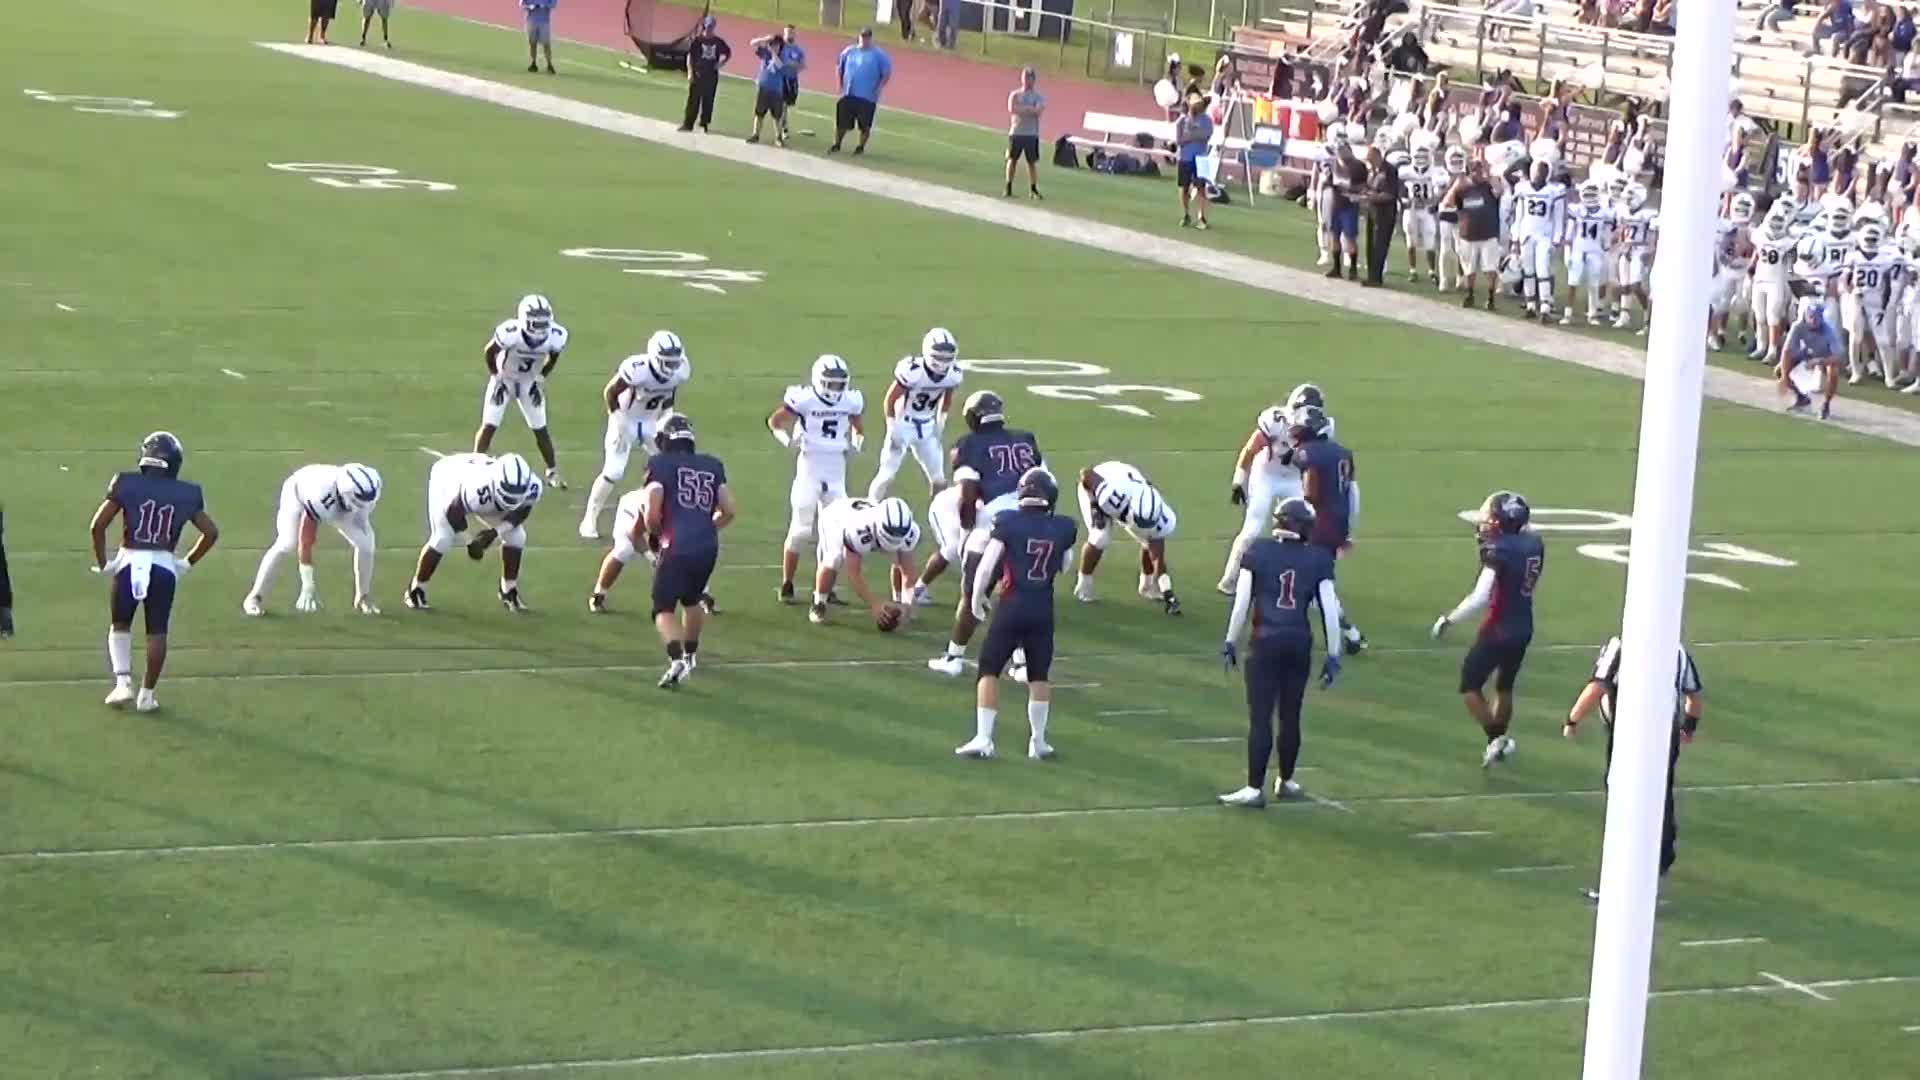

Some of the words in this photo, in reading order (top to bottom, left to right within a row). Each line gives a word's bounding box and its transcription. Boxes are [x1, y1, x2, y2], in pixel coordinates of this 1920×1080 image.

[1527, 199, 1547, 217] 23
[1856, 269, 1879, 288] 20
[518, 356, 537, 373] 3
[956, 358, 1204, 402] 30
[911, 392, 944, 411] 34
[821, 420, 838, 440] 5
[677, 466, 716, 510] 55
[134, 498, 175, 544] 11
[1026, 538, 1056, 581] 7
[1519, 556, 1542, 598] 5
[1276, 568, 1296, 609] 1
